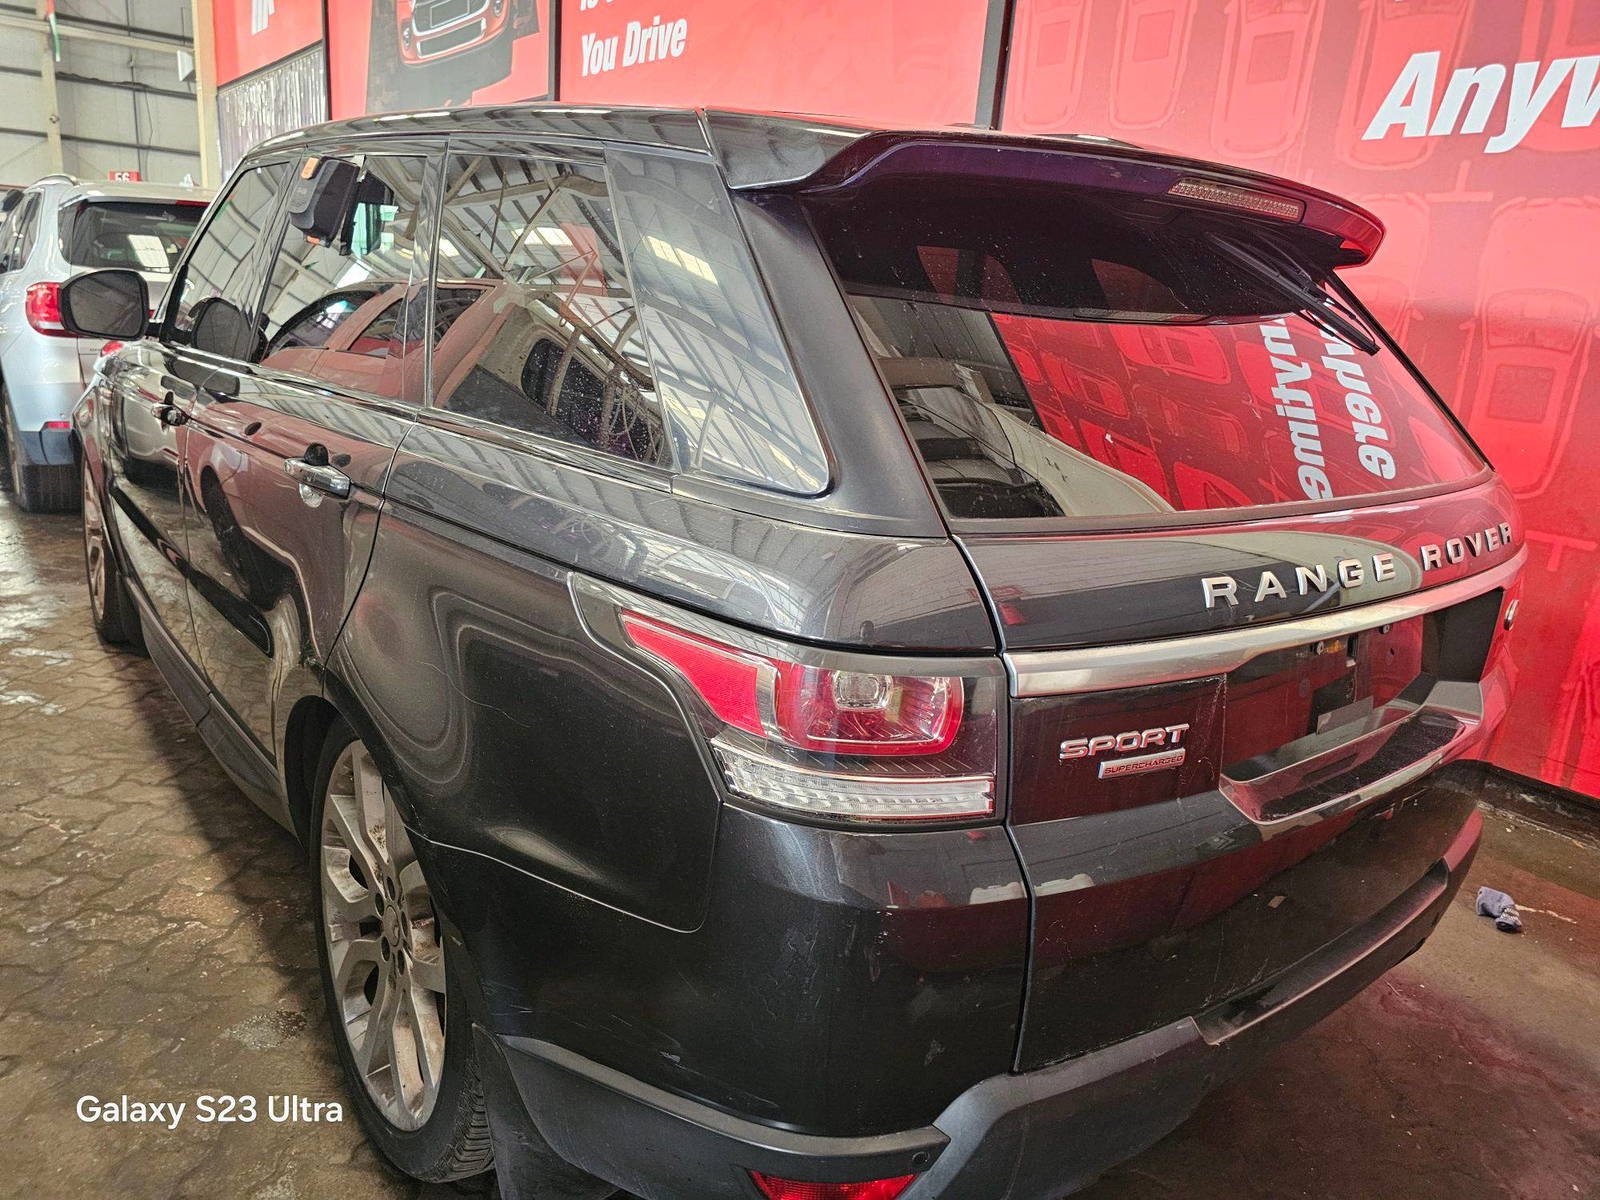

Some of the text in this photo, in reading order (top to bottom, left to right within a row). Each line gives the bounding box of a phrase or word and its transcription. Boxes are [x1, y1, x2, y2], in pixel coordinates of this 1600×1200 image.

[581, 15, 688, 77] You Drive
[1201, 521, 1514, 609] RANGE ROVER
[1059, 723, 1190, 760] SPORT
[1103, 755, 1184, 775] SUPERCHARGED
